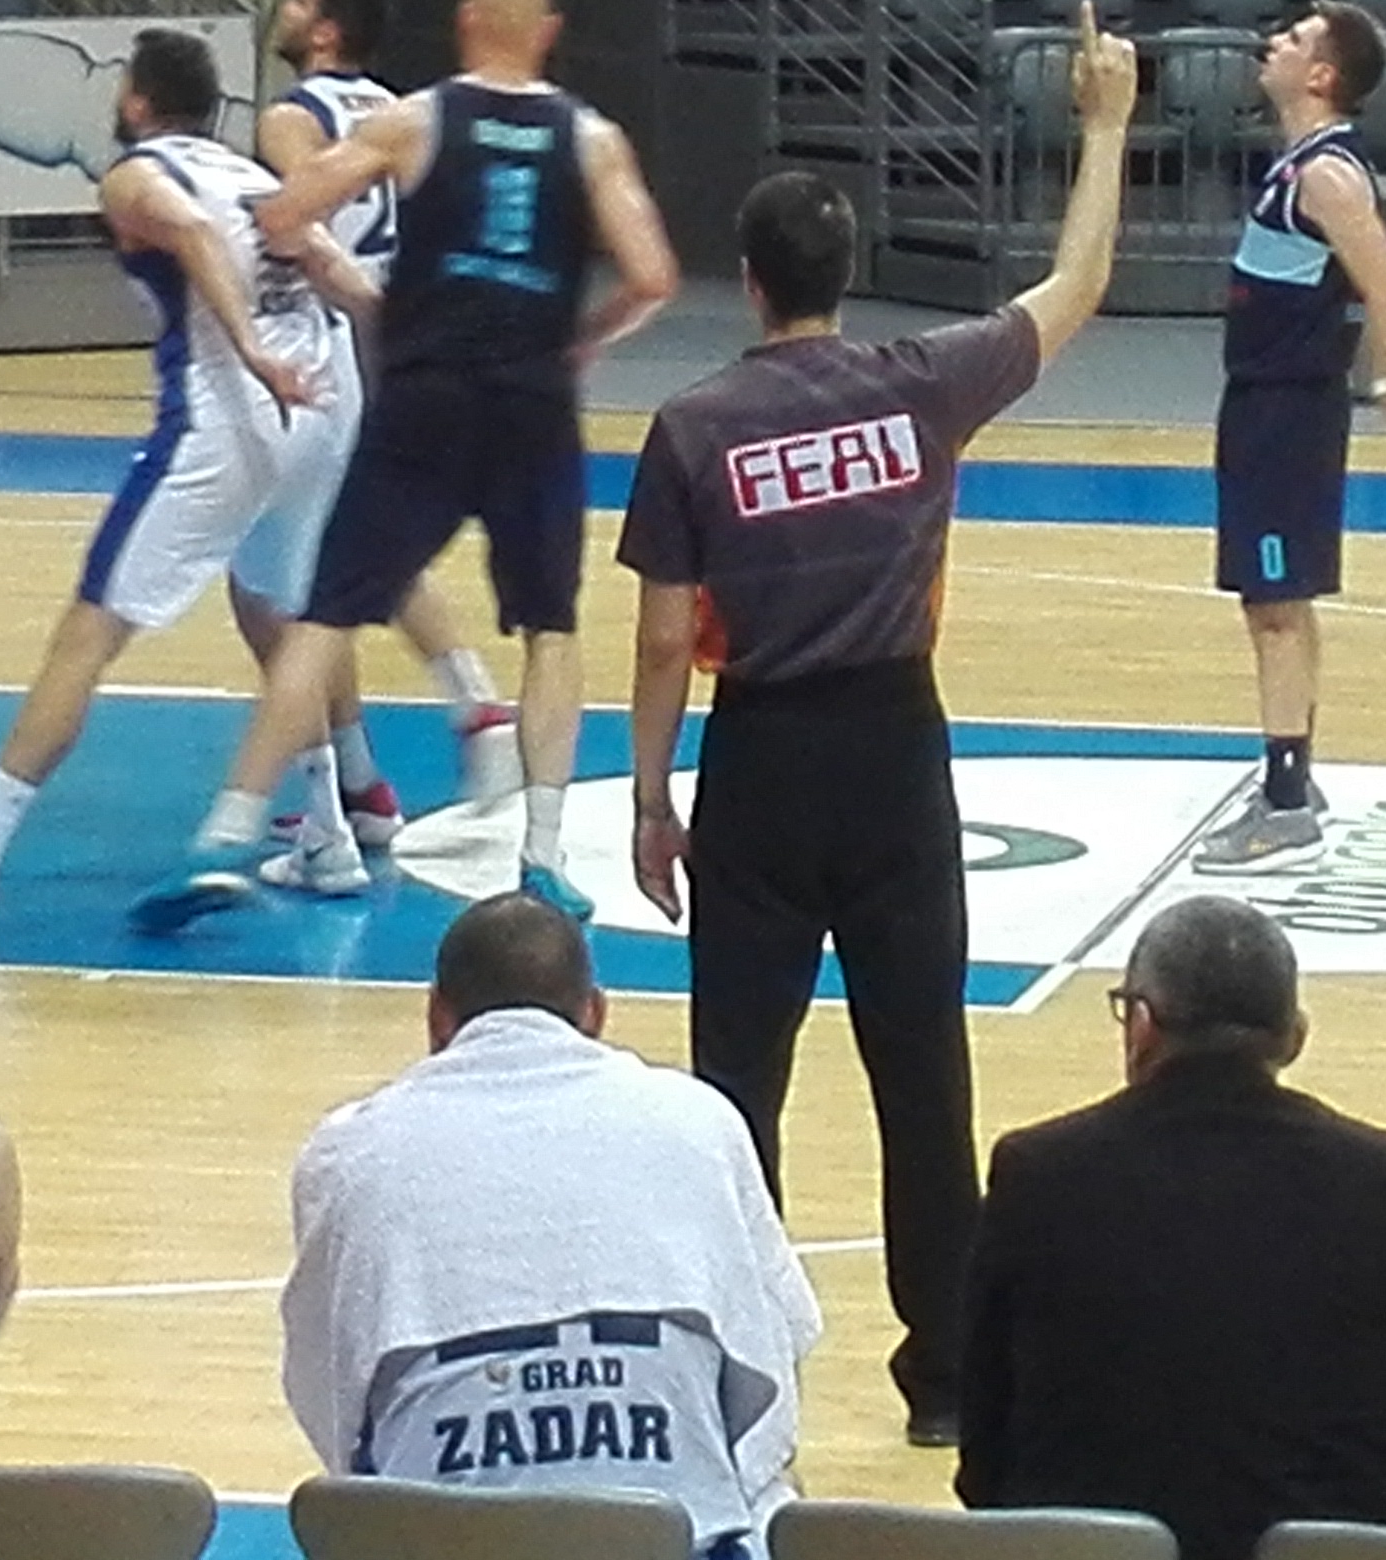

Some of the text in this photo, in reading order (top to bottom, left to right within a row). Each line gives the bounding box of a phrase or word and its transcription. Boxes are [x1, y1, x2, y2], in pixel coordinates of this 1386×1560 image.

[1261, 534, 1284, 581] 0
[521, 1357, 624, 1392] GRAD
[434, 1401, 673, 1474] ZADAR
